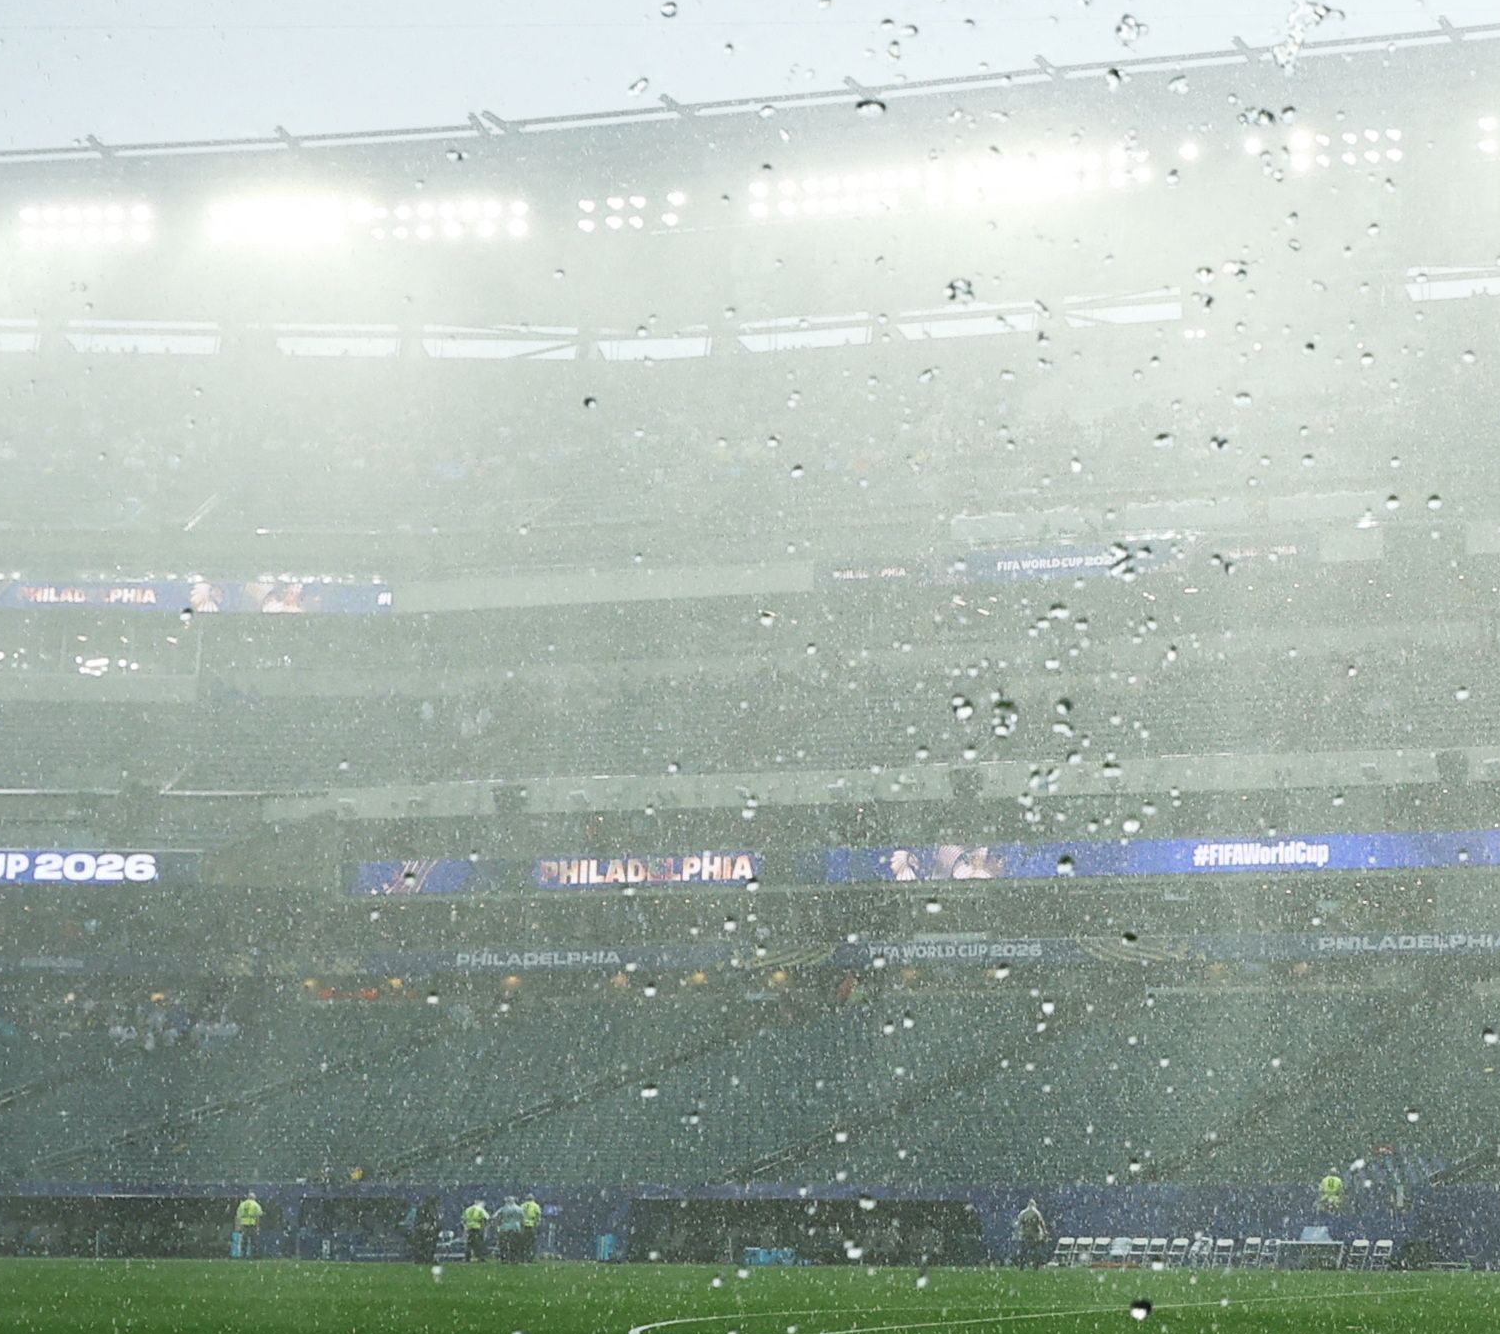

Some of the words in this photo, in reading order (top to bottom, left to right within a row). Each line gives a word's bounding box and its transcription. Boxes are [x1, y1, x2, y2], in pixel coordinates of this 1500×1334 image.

[997, 561, 1021, 571] FIFA
[1021, 558, 1060, 570] WORLD
[1061, 556, 1084, 567] CUP
[1084, 555, 1121, 567] 202
[1193, 841, 1329, 867] #FIFAWorldCup
[34, 853, 157, 881] 2026
[457, 951, 621, 966] PHILADELPHIA
[902, 945, 956, 959] WORLD
[958, 943, 987, 957] CUP
[990, 942, 1042, 957] 2026
